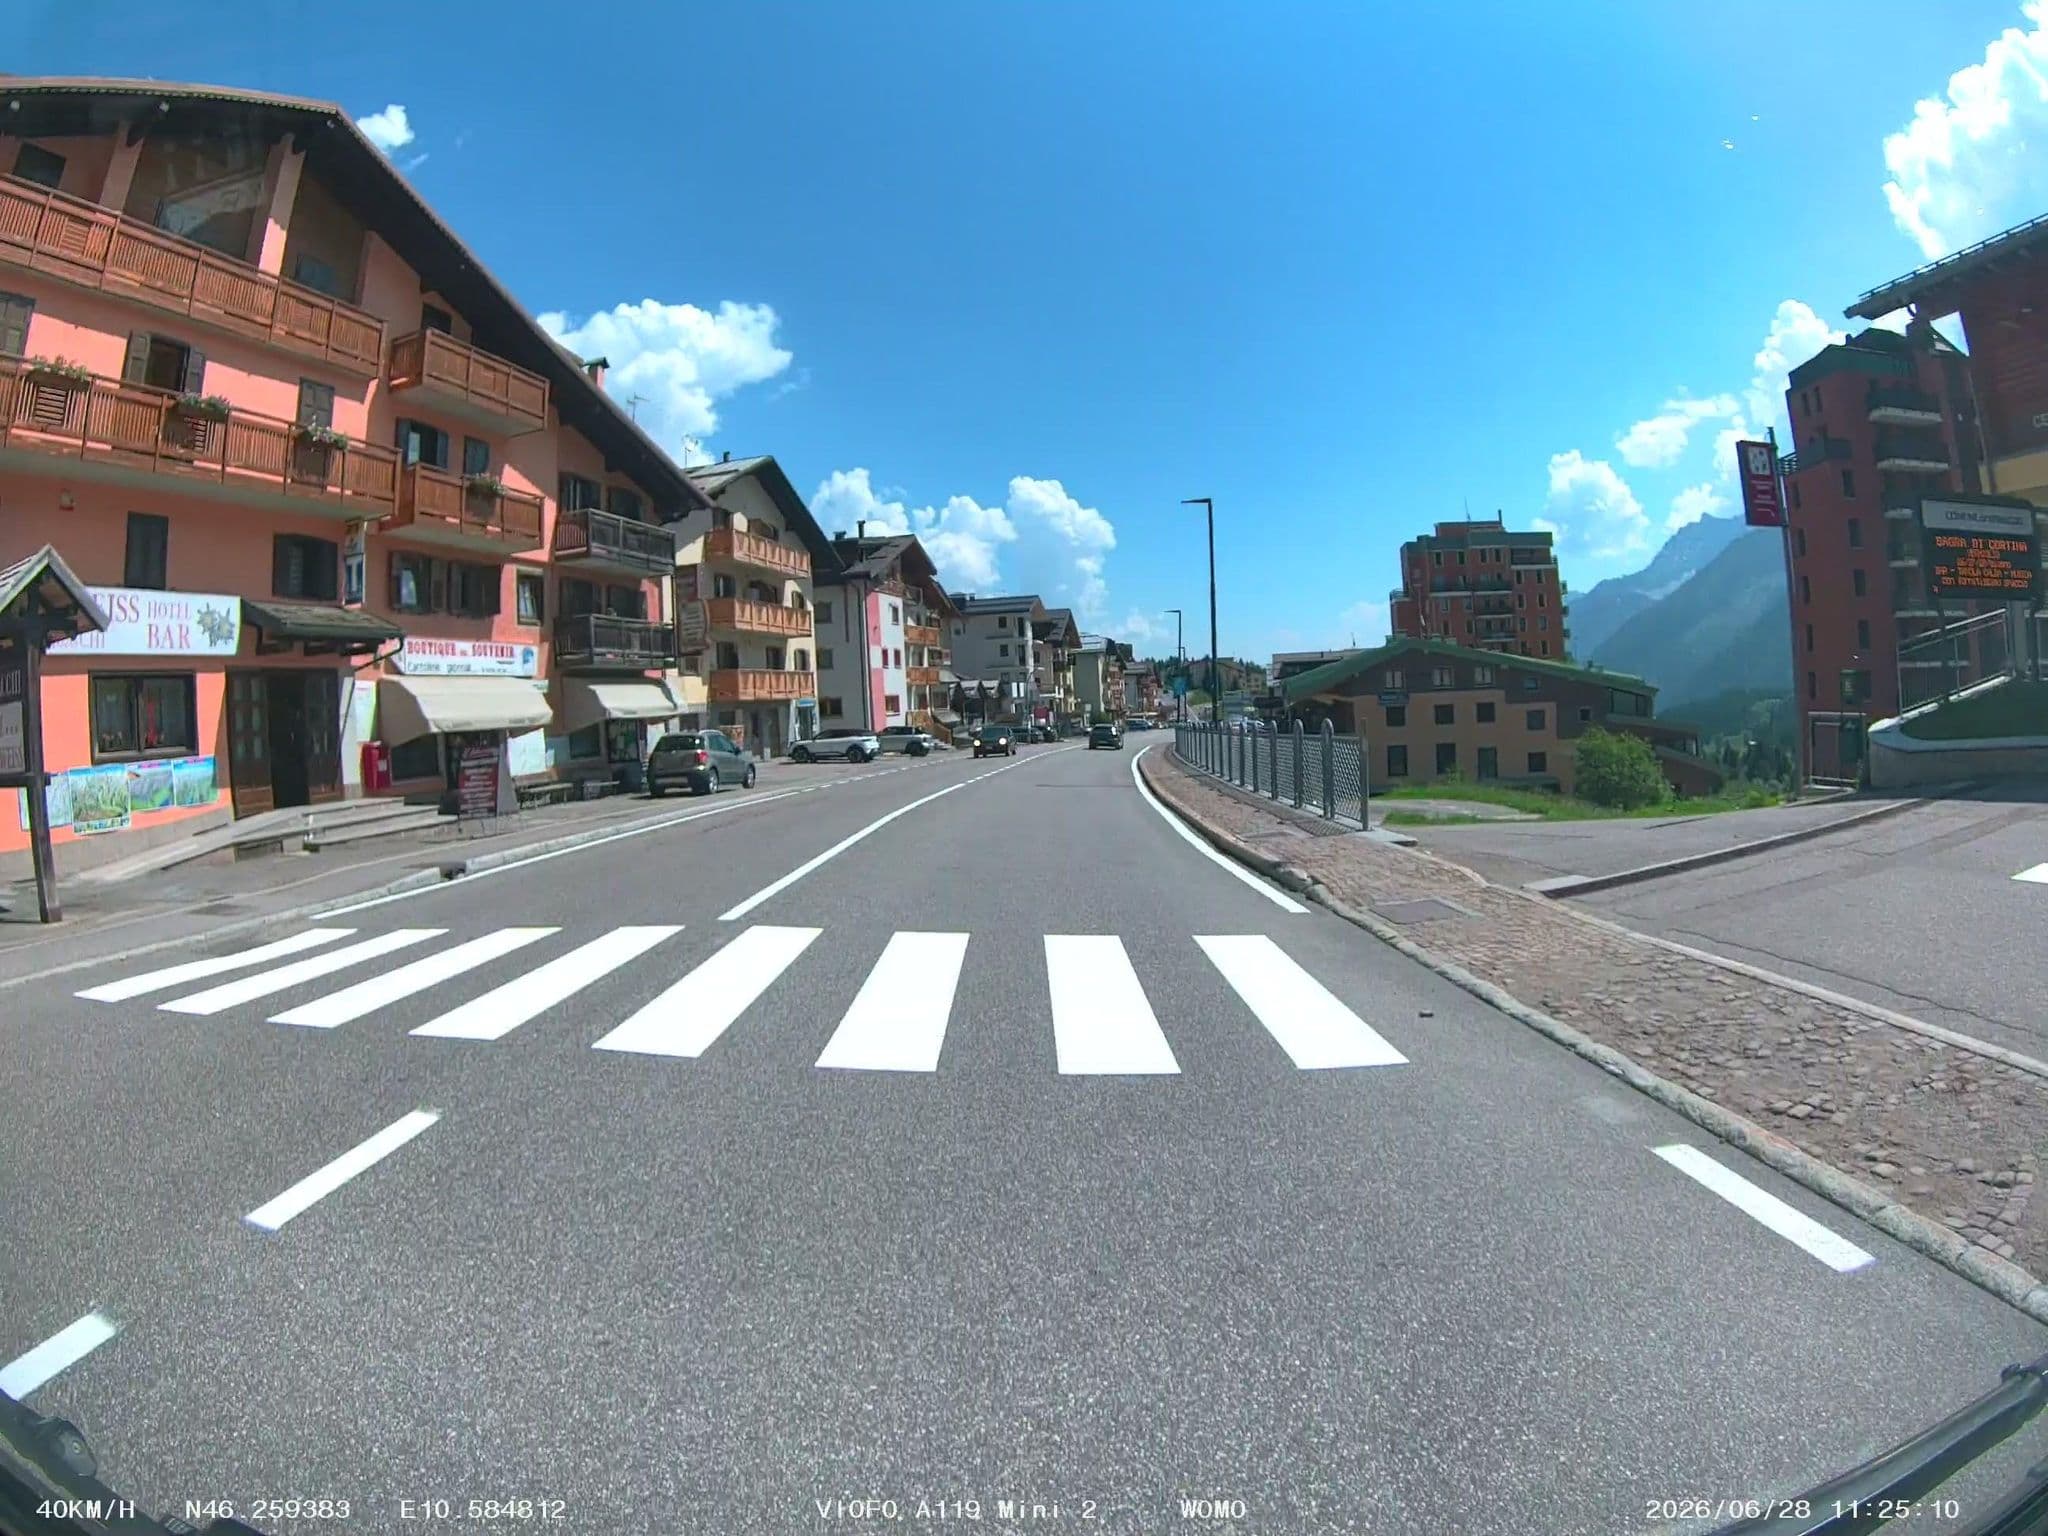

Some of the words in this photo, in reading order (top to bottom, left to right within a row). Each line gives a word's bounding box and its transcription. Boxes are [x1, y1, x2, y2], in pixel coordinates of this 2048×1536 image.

[148, 601, 191, 619] HOTEL
[147, 624, 191, 649] BAR
[407, 640, 457, 657] BOUTIQUE
[472, 643, 516, 658] SOUVENIR
